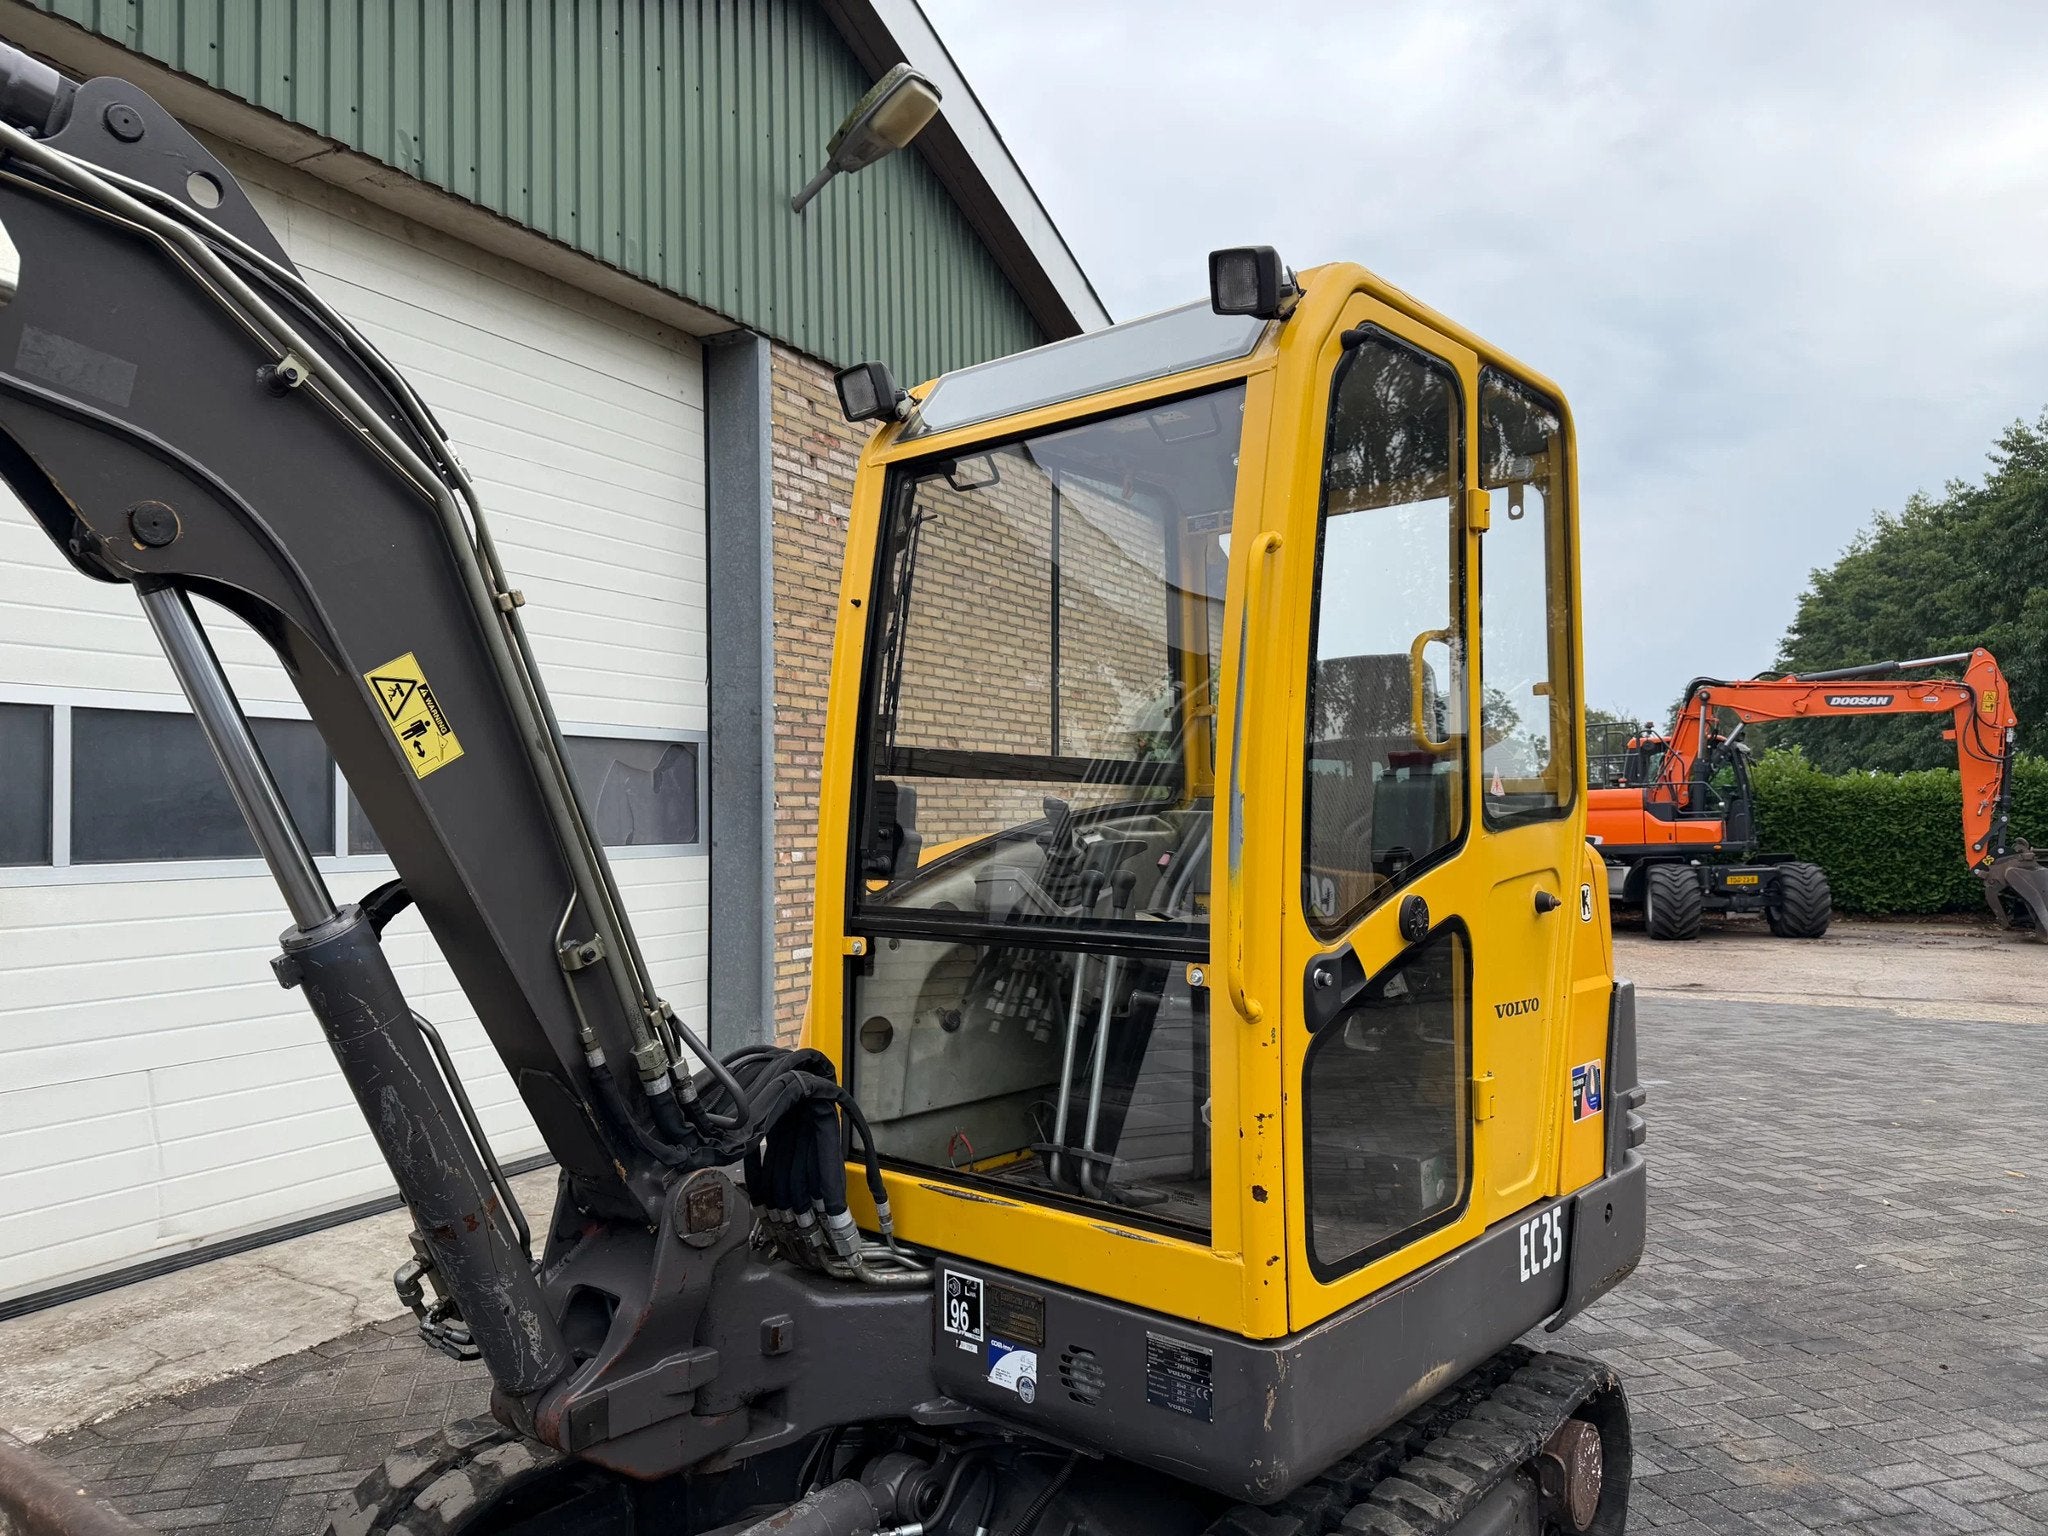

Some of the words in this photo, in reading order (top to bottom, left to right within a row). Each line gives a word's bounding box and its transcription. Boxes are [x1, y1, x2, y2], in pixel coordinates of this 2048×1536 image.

[1829, 696, 1889, 706] DOOSAN
[425, 697, 448, 735] WARNING
[1581, 889, 1591, 915] K
[1494, 997, 1539, 1019] VOLVO
[1520, 1206, 1562, 1282] EC35
[950, 1298, 969, 1331] 96
[1166, 1368, 1192, 1380] VOLVO
[1166, 1401, 1193, 1414] VOLVO
